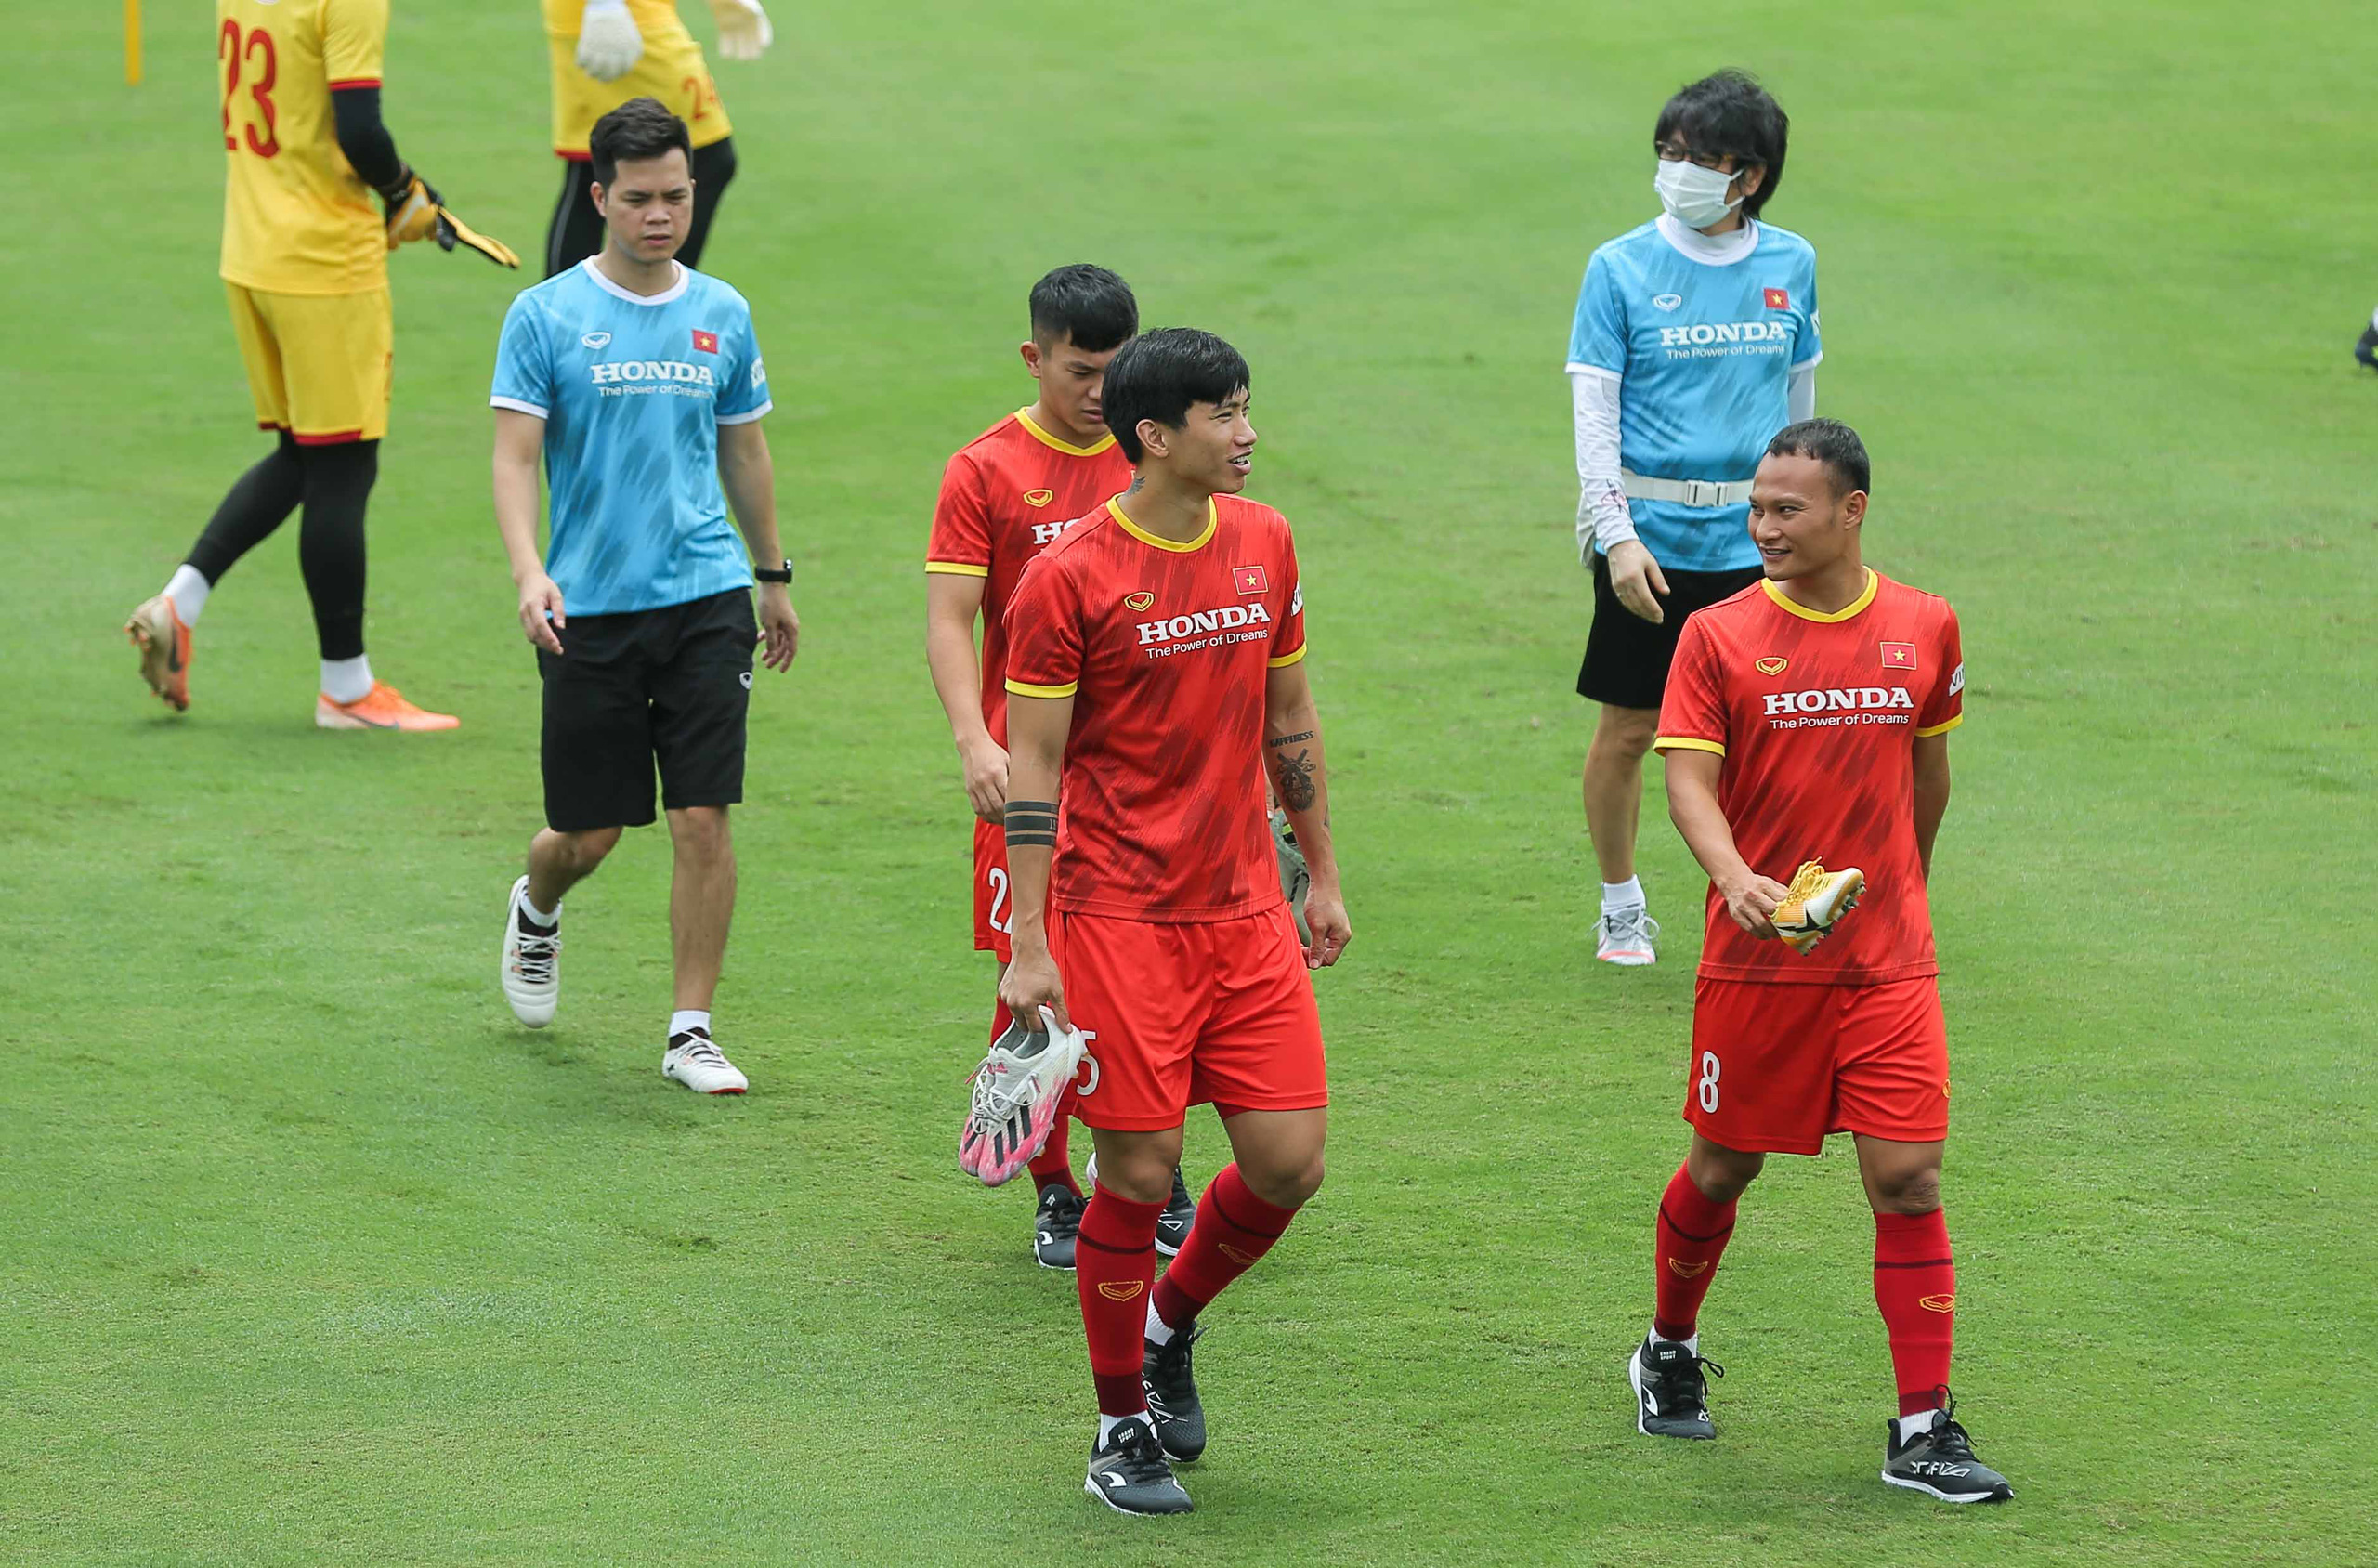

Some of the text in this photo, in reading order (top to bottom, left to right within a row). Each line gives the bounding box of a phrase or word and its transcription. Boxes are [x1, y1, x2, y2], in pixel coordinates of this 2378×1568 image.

[219, 19, 280, 159] 23
[1660, 321, 1787, 346] HONDA
[1666, 344, 1784, 359] The Power of Dreams
[590, 360, 714, 386] HONDA
[598, 384, 712, 398] The Power of Dreams
[1136, 603, 1271, 645] HONDA
[1145, 629, 1269, 659] The Power of Dreams
[1762, 687, 1914, 715] HONDA
[1770, 713, 1909, 729] The Power of Dreams
[1699, 1051, 1721, 1114] 8
